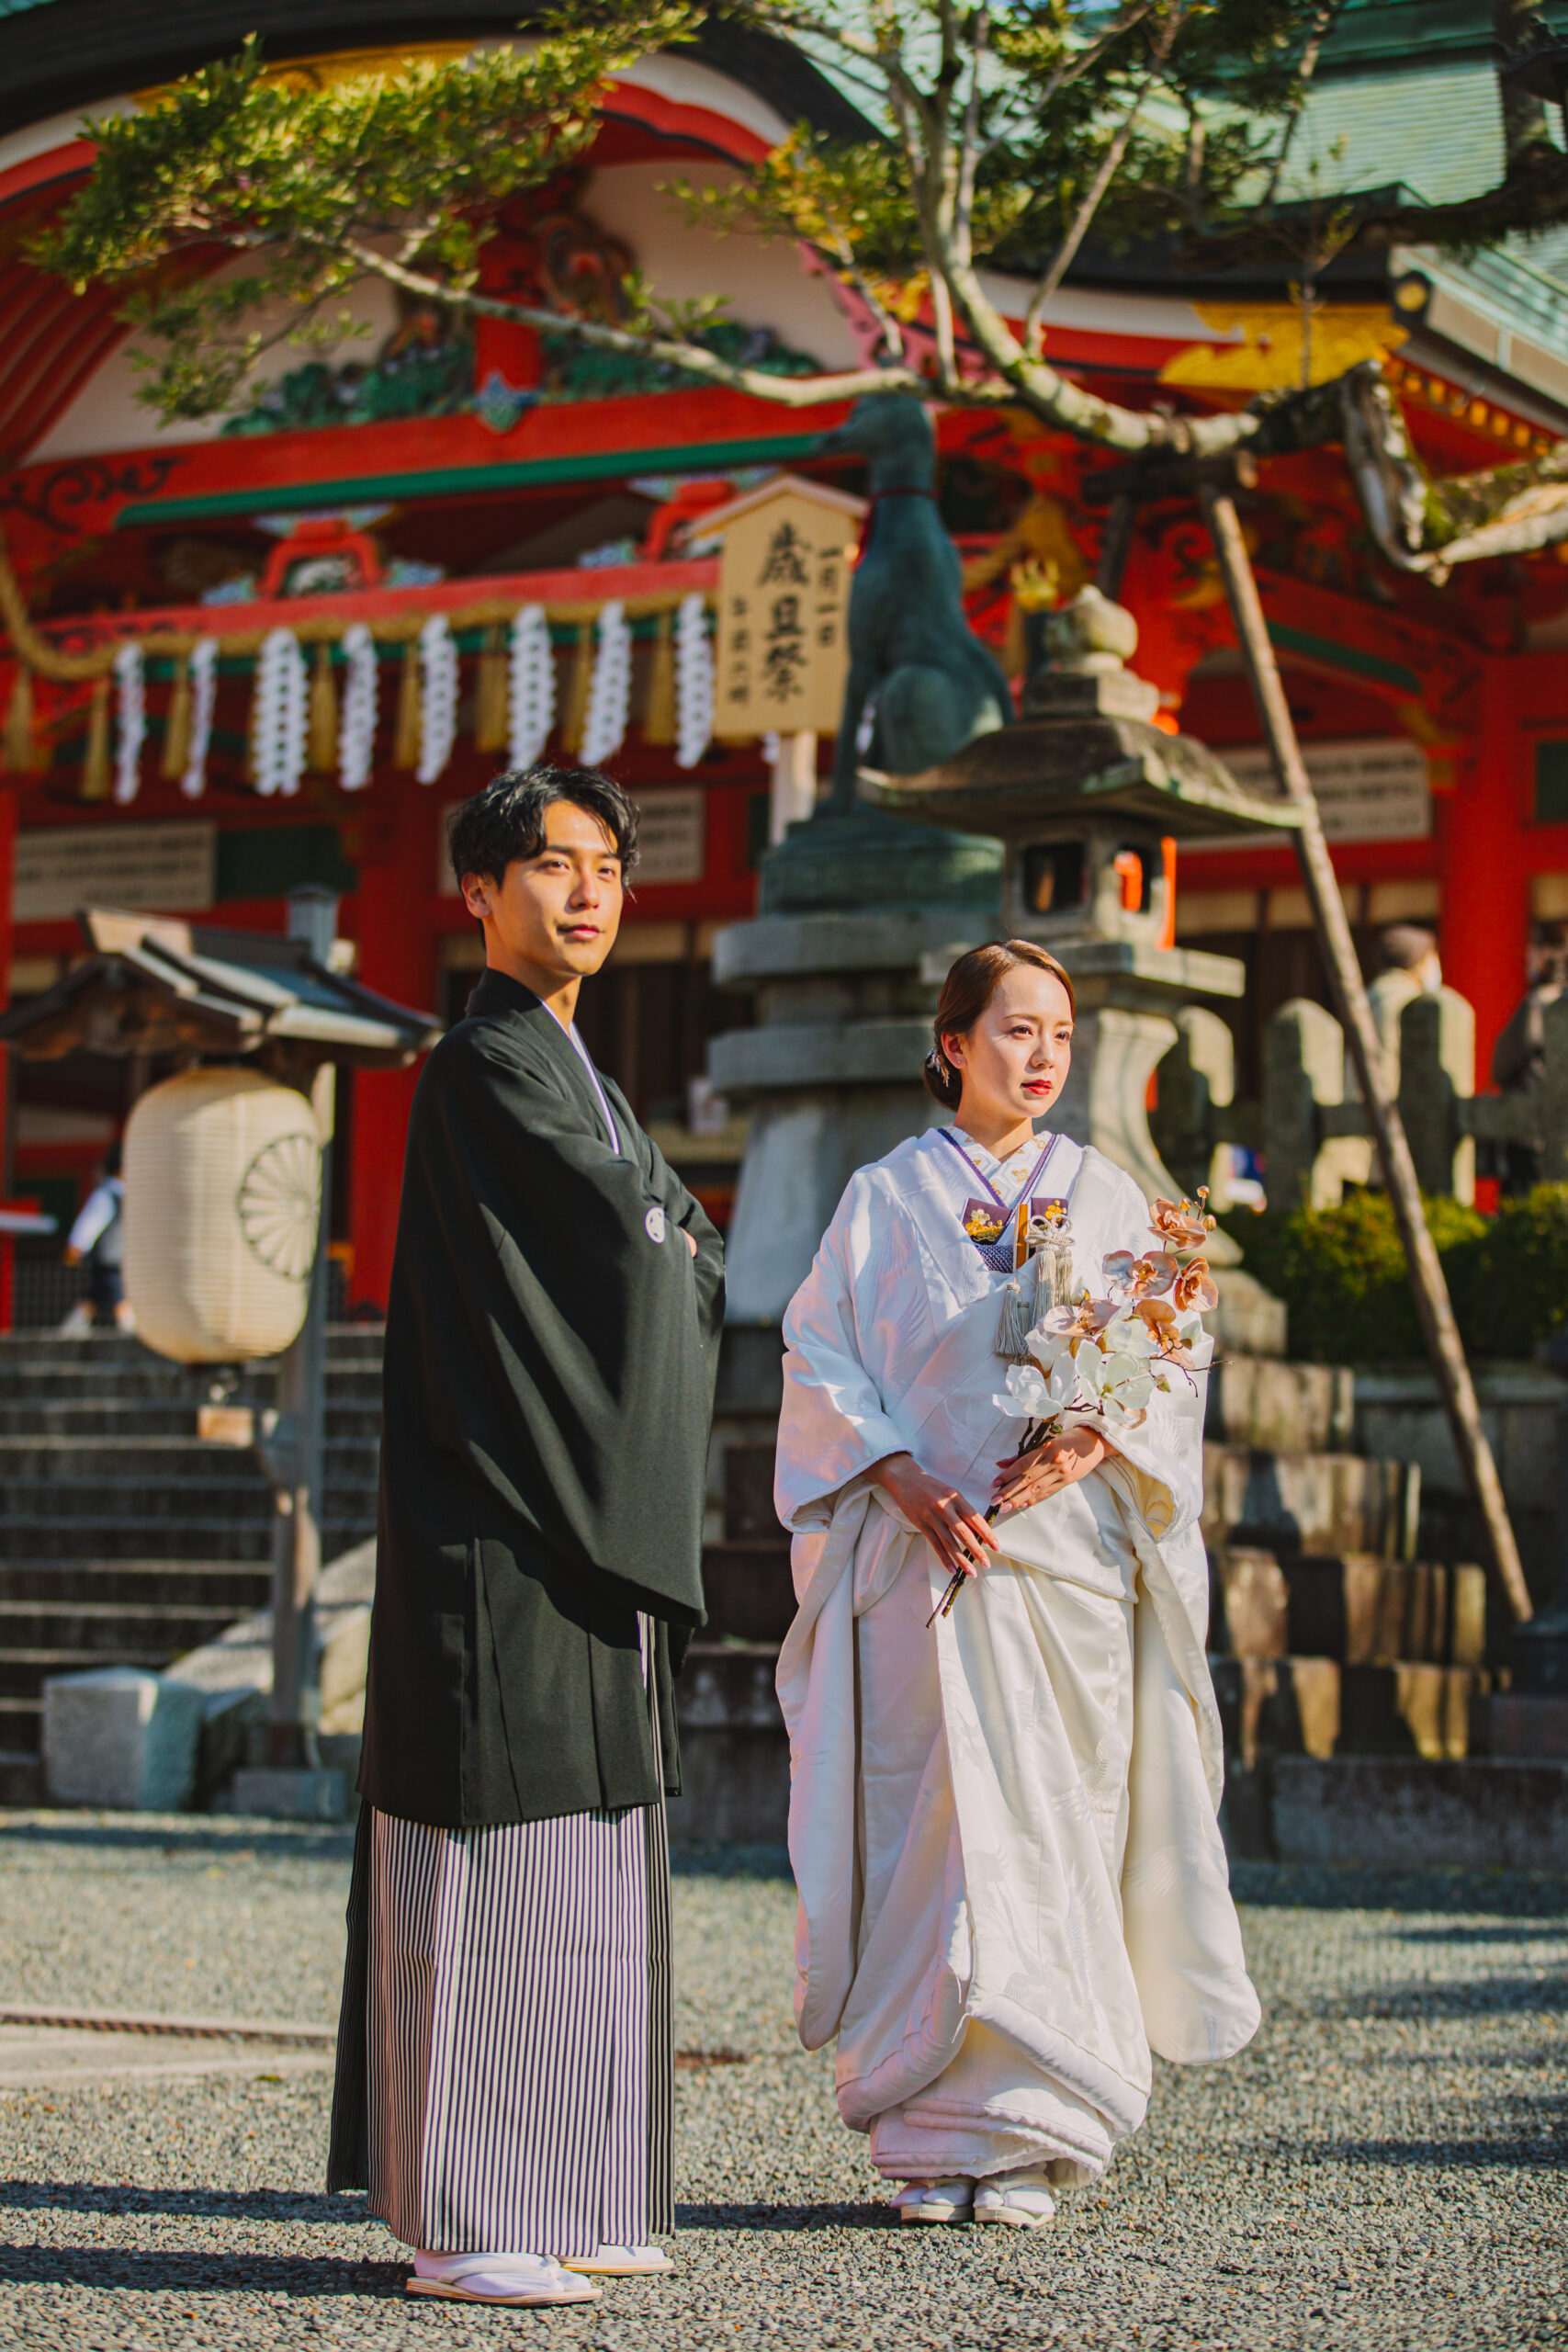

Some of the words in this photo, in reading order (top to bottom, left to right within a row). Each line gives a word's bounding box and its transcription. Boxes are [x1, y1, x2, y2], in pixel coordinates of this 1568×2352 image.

[759, 521, 808, 703] 歳旦祭
[817, 548, 841, 646] 一月一日
